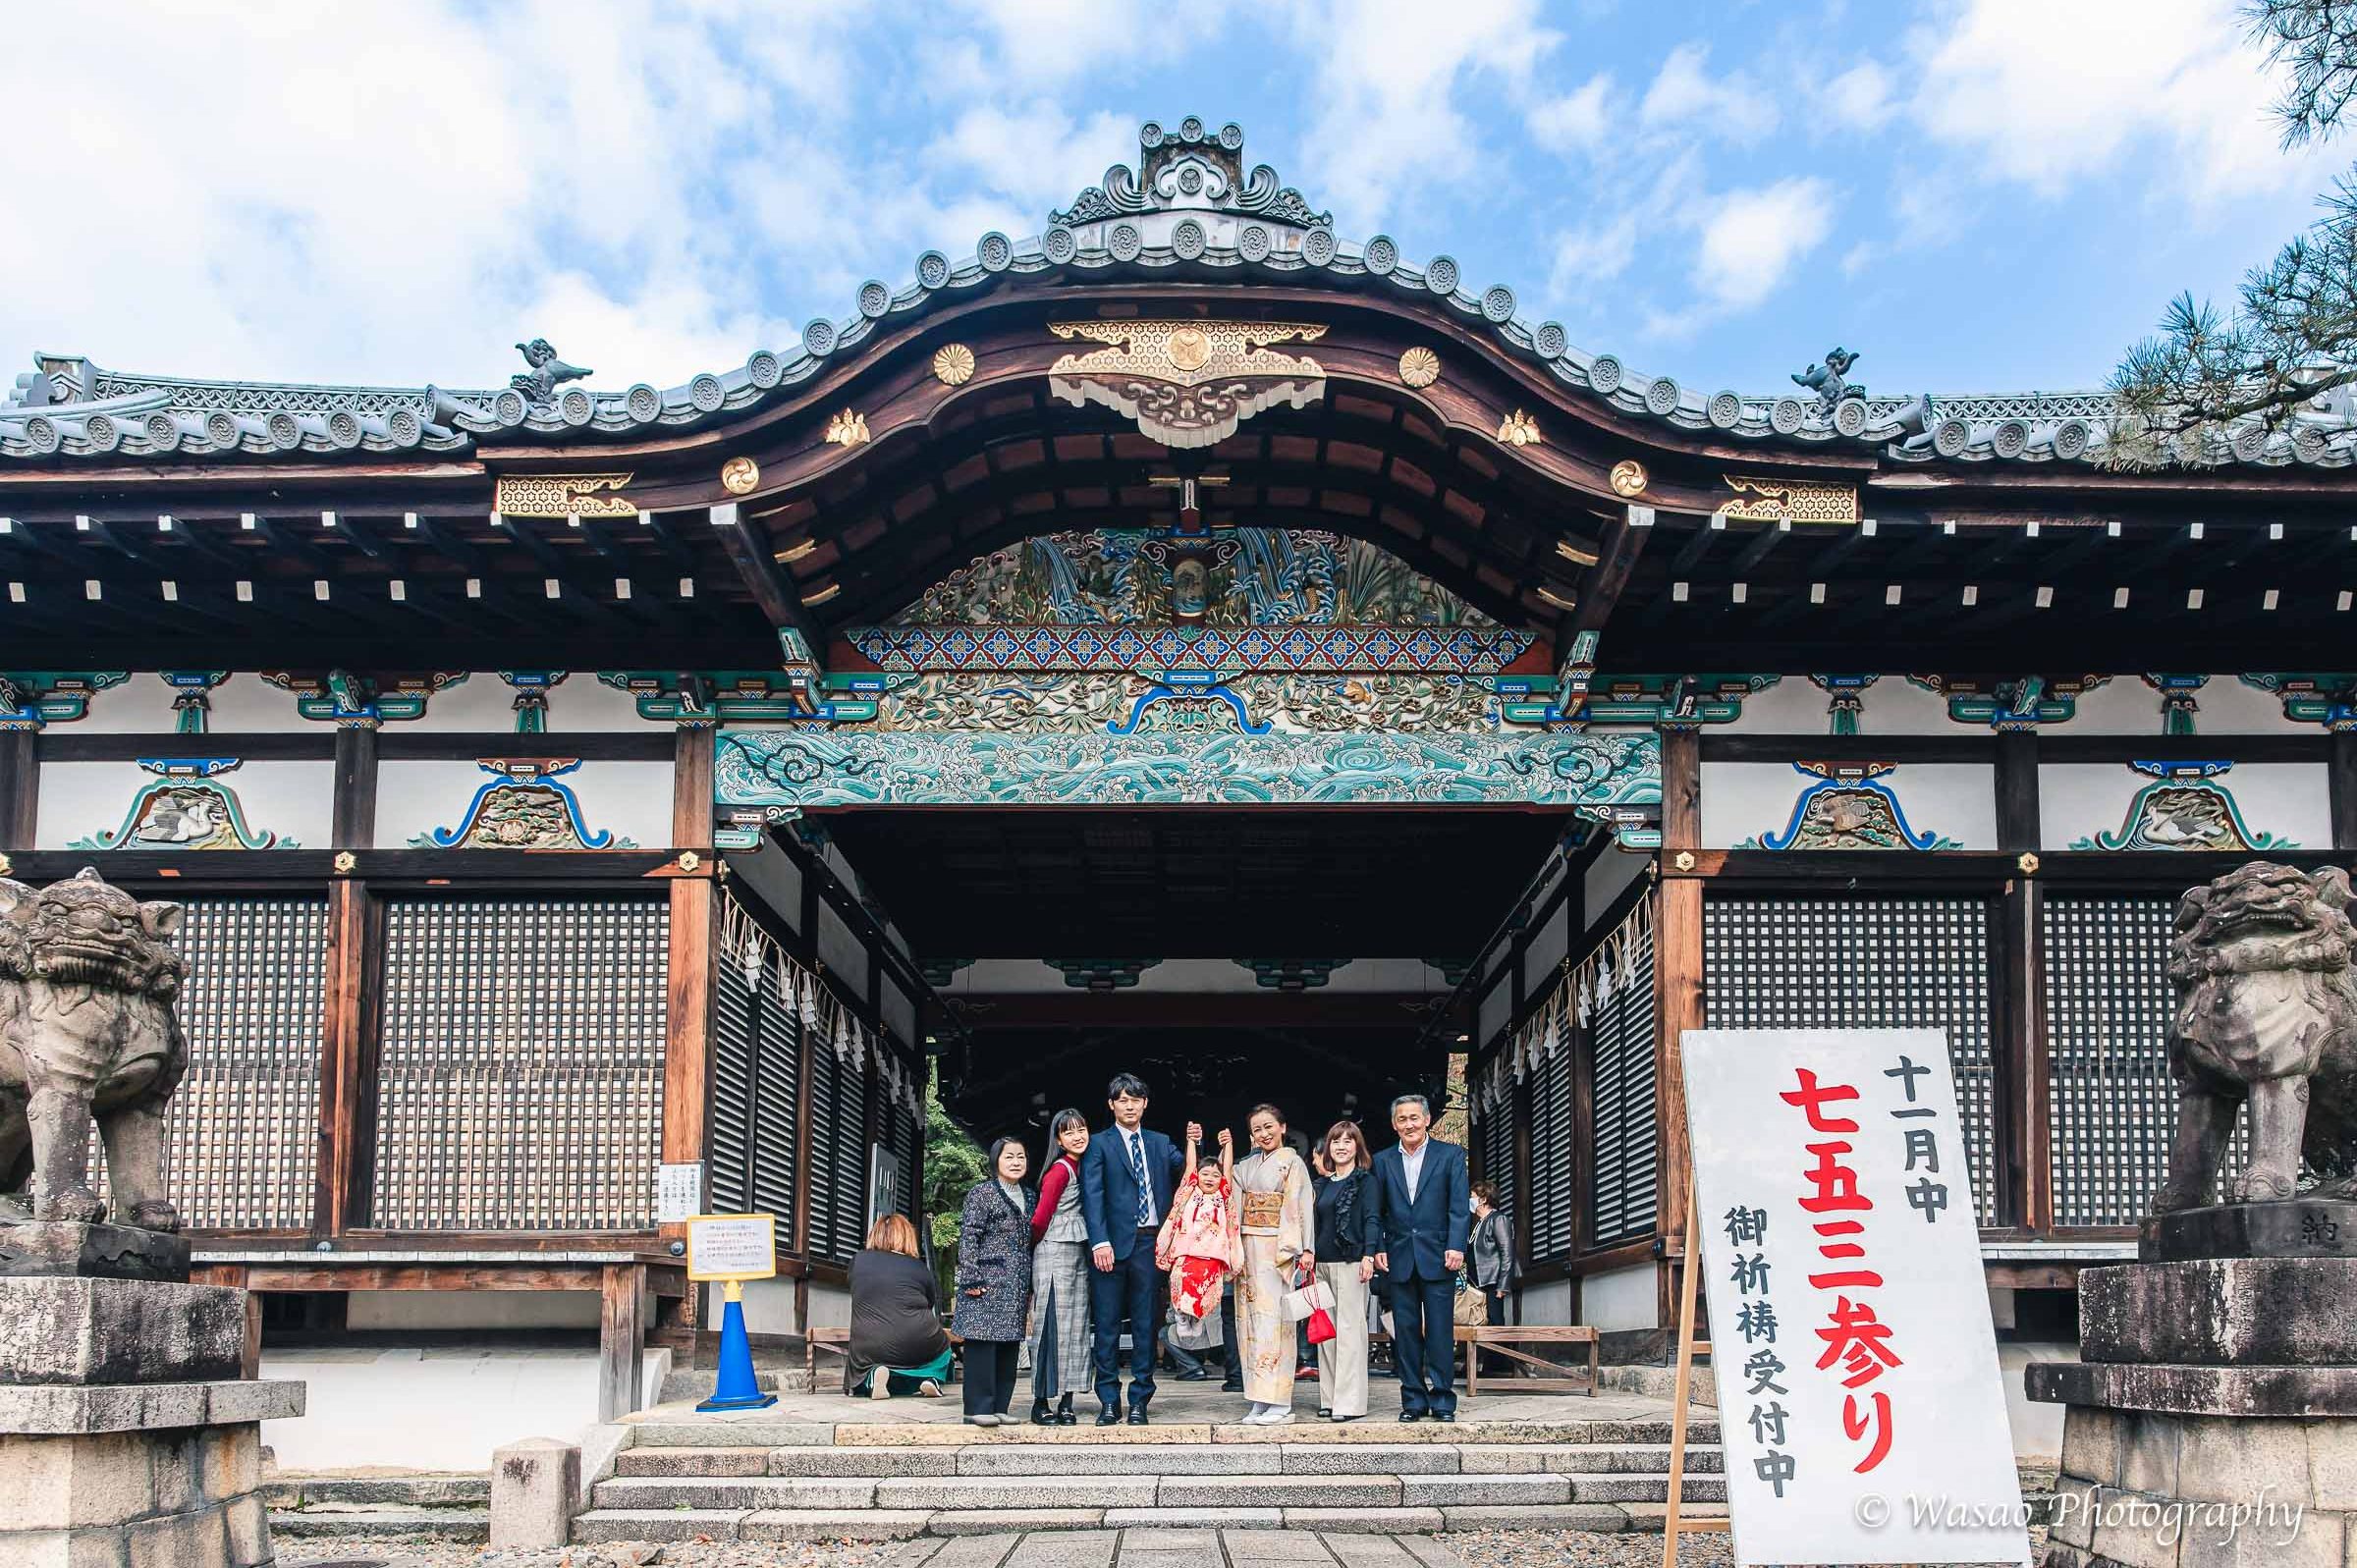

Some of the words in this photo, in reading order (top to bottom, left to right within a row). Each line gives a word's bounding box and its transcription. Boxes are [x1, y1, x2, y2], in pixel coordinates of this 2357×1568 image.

[1780, 1067, 1903, 1474] 七五三参り
[1883, 1054, 1948, 1224] 十一月中
[1723, 1206, 1796, 1499] 御祈祷受付中
